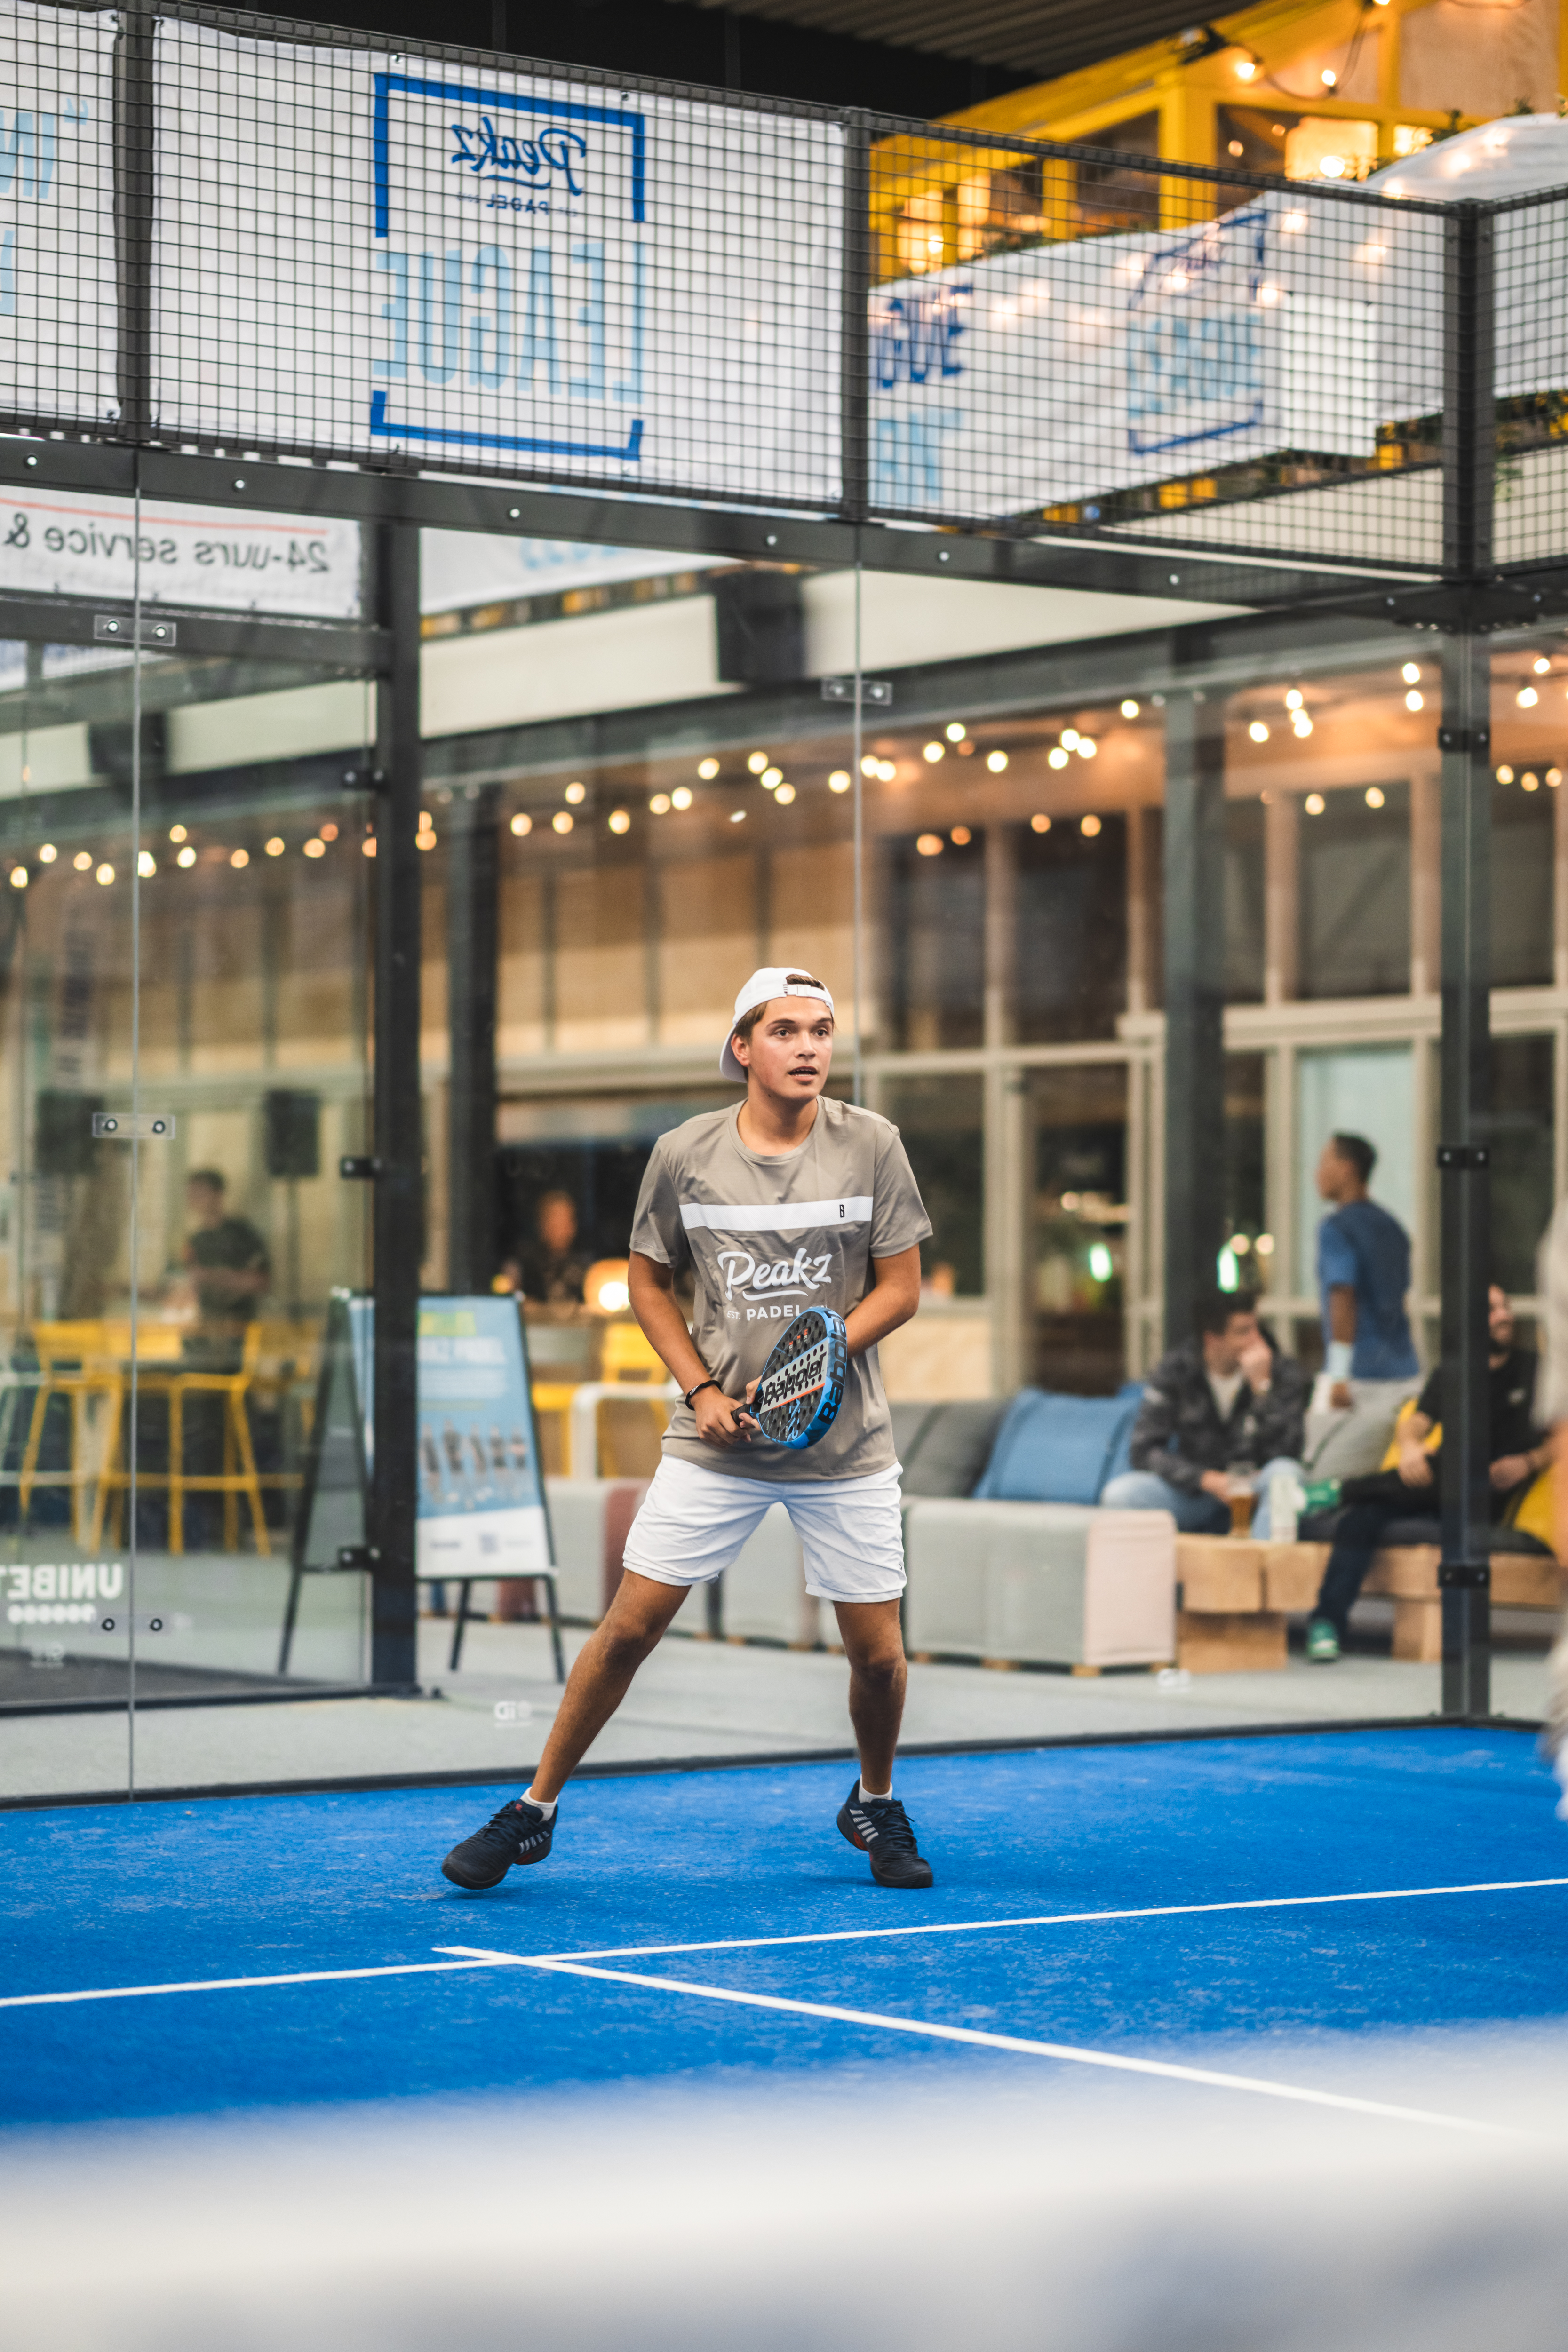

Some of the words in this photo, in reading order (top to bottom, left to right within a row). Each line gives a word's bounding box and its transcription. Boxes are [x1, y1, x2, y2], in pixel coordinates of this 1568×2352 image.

[839, 1204, 845, 1218] B
[717, 1248, 833, 1301] Peakz
[727, 1311, 741, 1320] EST.
[747, 1304, 801, 1321] PADEL
